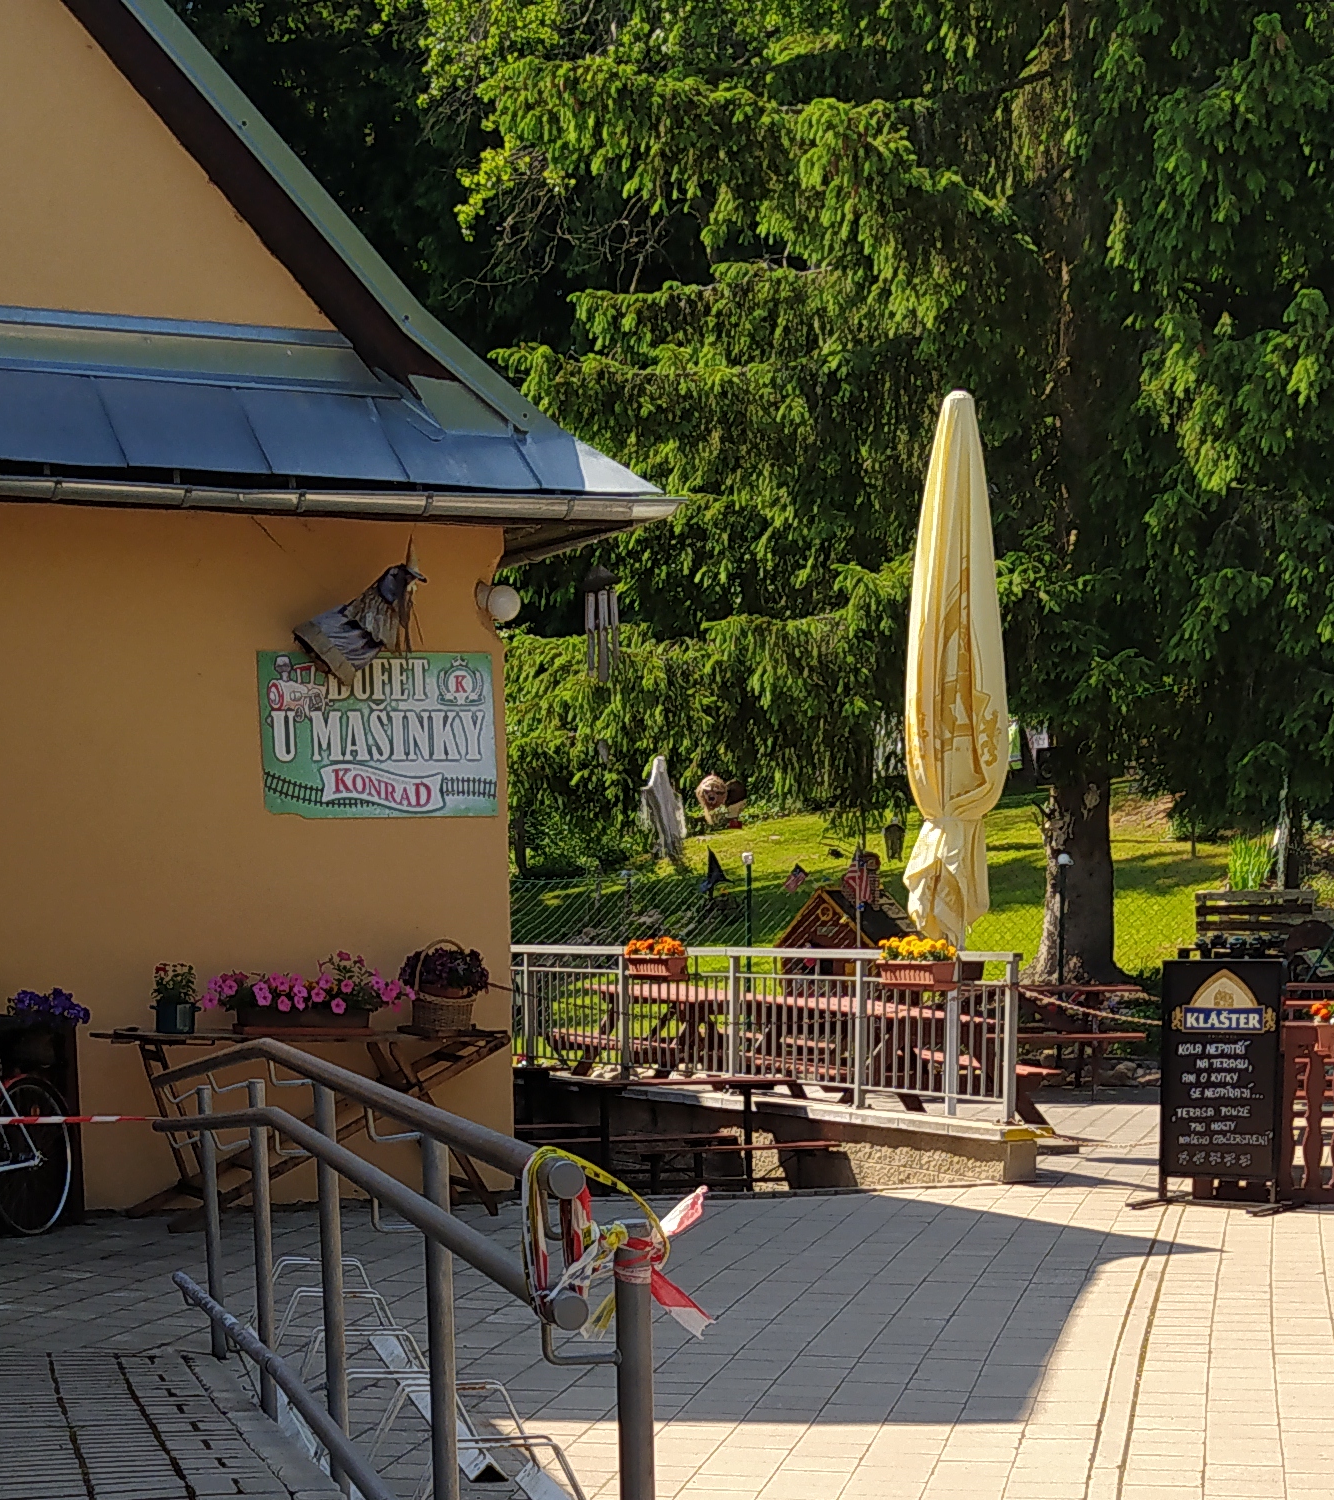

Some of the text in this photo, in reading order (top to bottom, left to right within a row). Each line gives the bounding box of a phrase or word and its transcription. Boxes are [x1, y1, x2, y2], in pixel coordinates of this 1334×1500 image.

[269, 702, 485, 763] U MAŠINKY
[331, 767, 433, 808] KONRAD
[1186, 1011, 1261, 1029] KLÁŠTER
[1178, 1043, 1202, 1055] KOLA
[1196, 1059, 1209, 1069] NA
